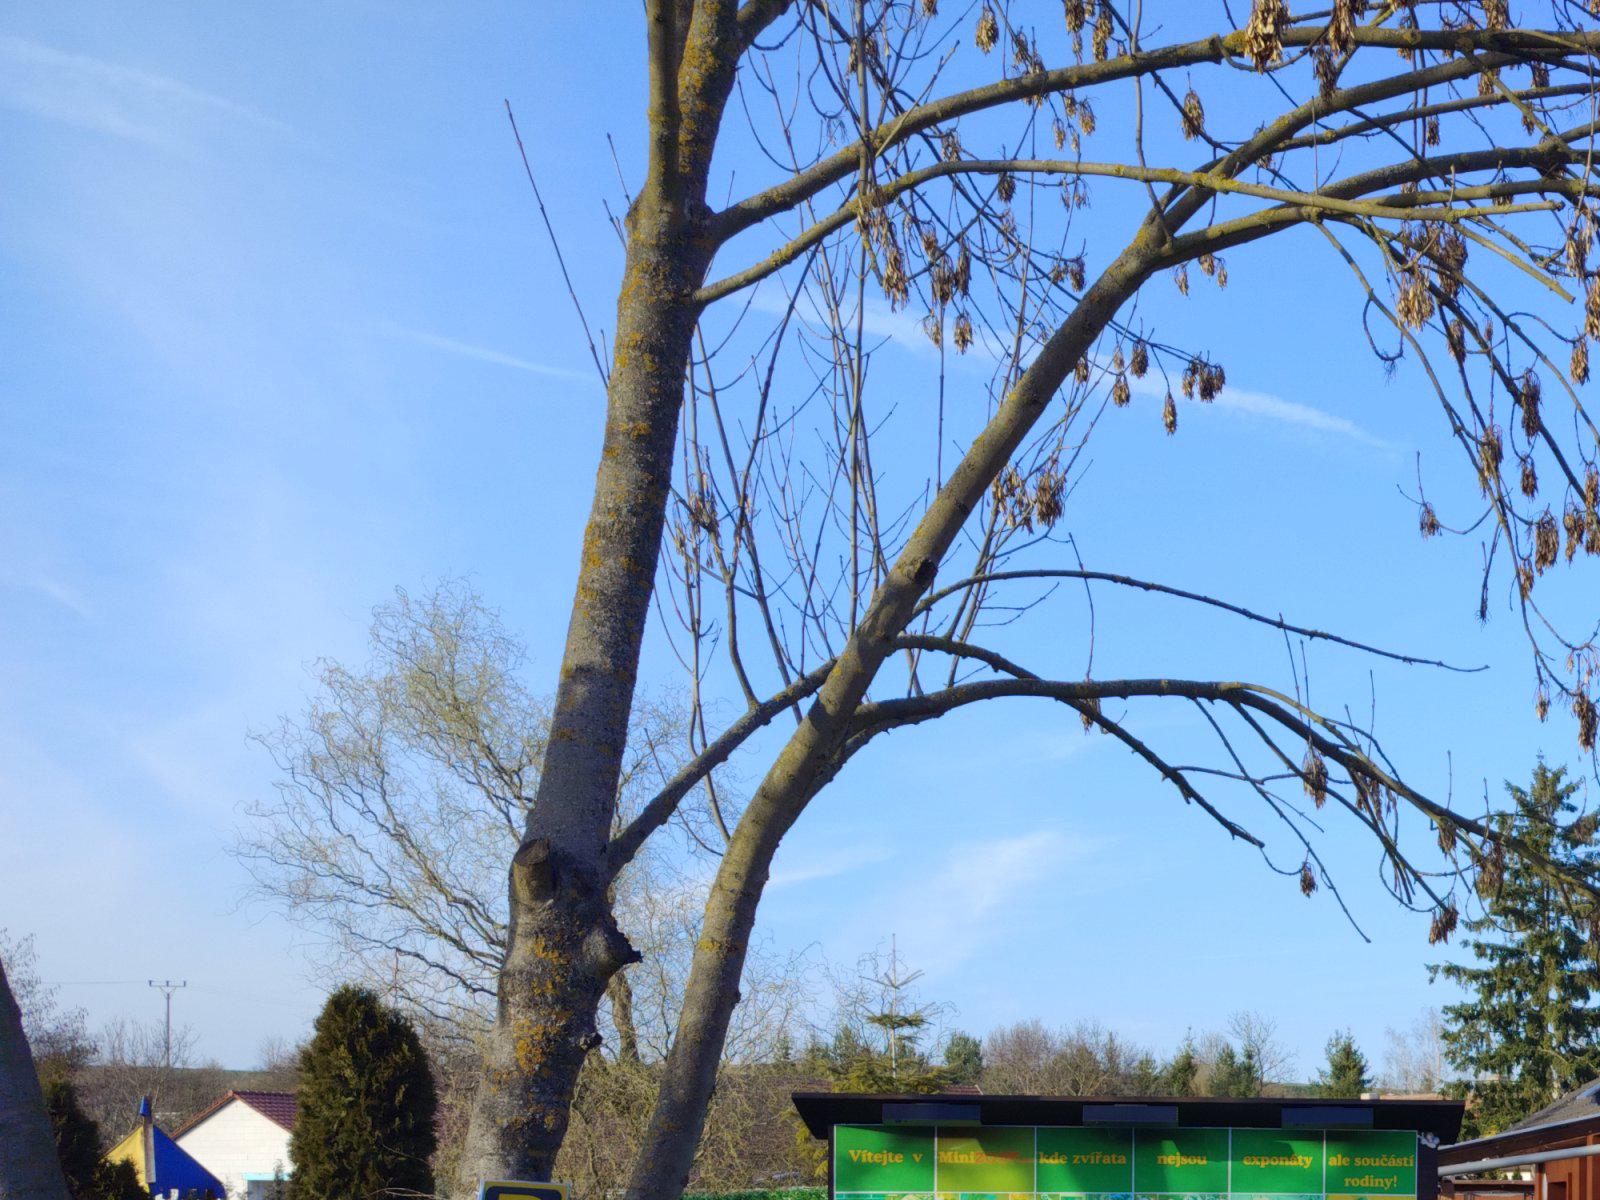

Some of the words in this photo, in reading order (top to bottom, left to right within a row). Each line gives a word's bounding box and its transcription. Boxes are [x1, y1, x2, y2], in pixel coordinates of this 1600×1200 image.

[848, 1149, 904, 1166] Vítejte
[912, 1153, 923, 1163] v
[1038, 1152, 1068, 1165] kde
[1072, 1151, 1127, 1165] zvířata
[1156, 1152, 1208, 1168] nejsou
[1242, 1153, 1313, 1169] exponáty
[1328, 1153, 1350, 1167] ale
[1354, 1153, 1415, 1168] součástí
[1343, 1175, 1398, 1190] rodiny!
